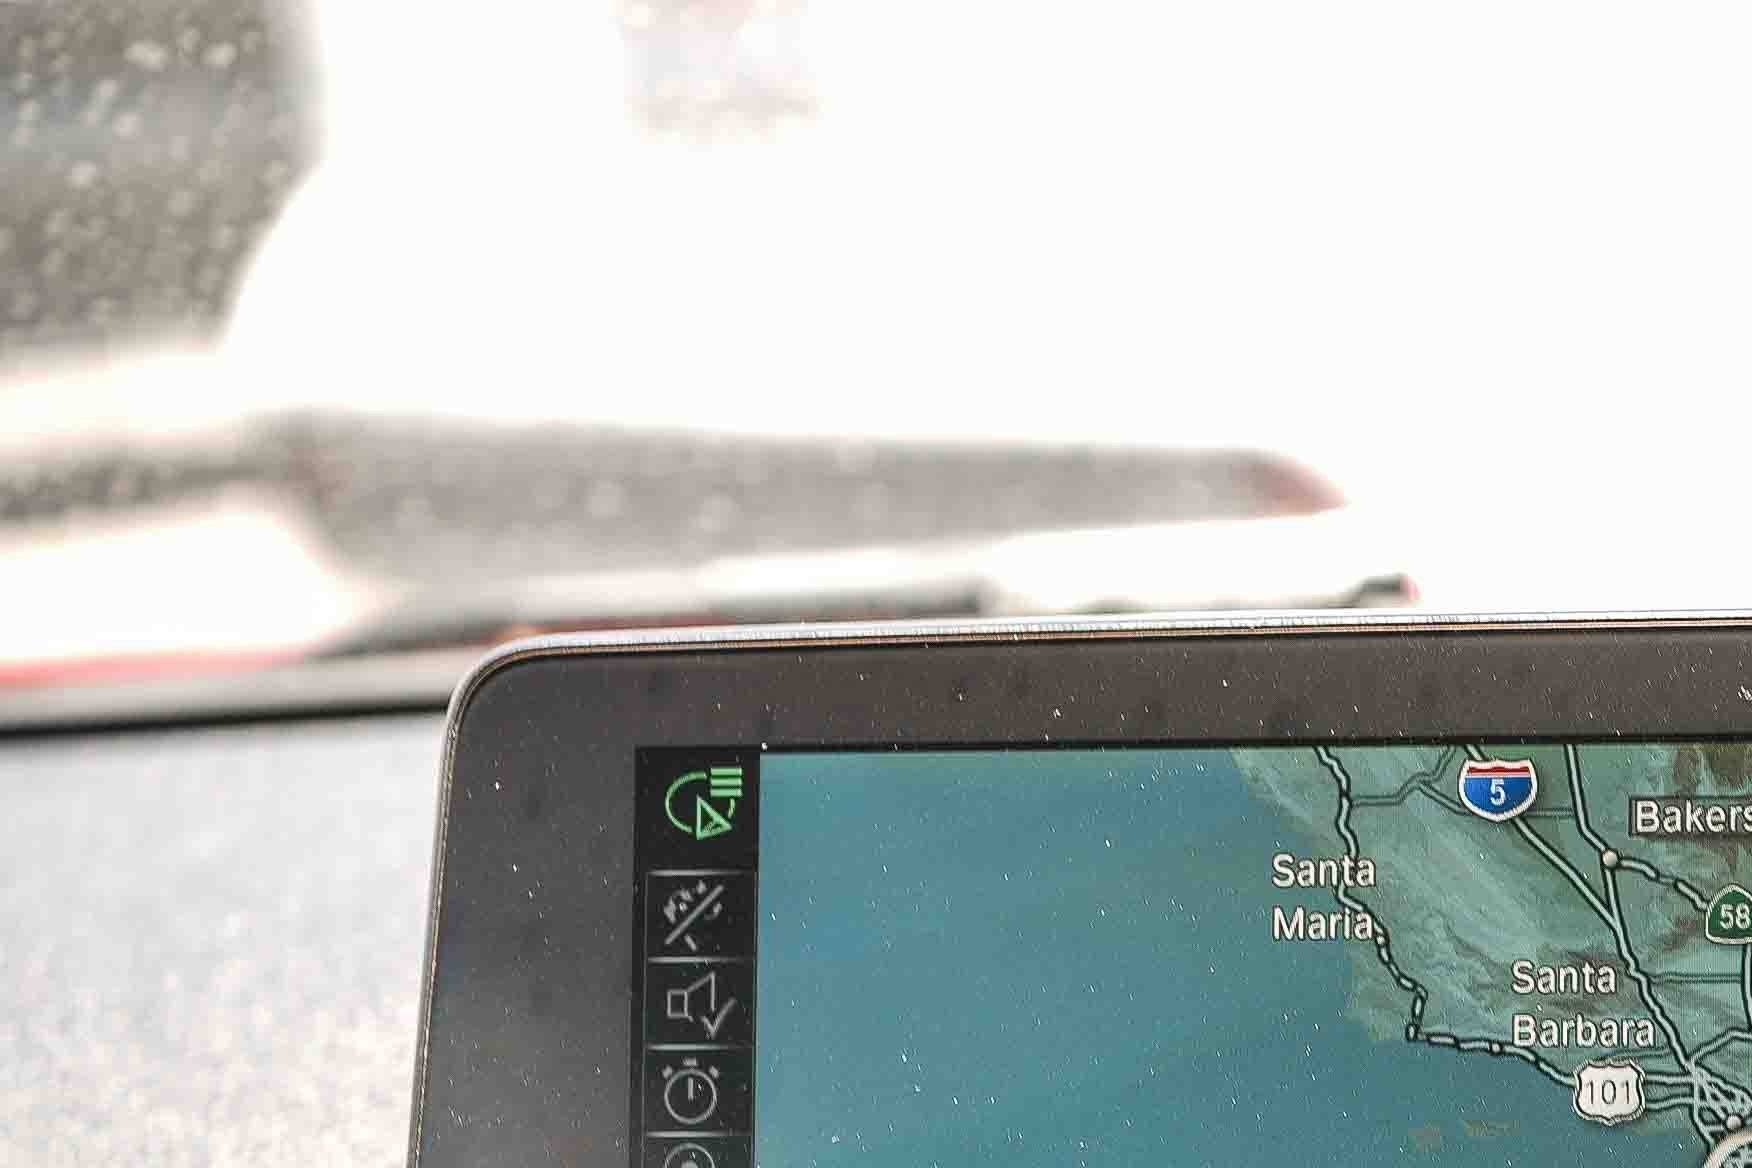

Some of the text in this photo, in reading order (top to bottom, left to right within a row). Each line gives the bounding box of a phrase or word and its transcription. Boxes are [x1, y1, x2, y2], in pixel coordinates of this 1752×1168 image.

[1488, 778, 1507, 806] 5
[1271, 853, 1377, 888] Santa
[1271, 906, 1376, 940] Maria
[1718, 904, 1752, 930] 58
[1510, 960, 1617, 994] Santa
[1510, 1014, 1656, 1048] Barbara
[1585, 1078, 1633, 1106] 101
